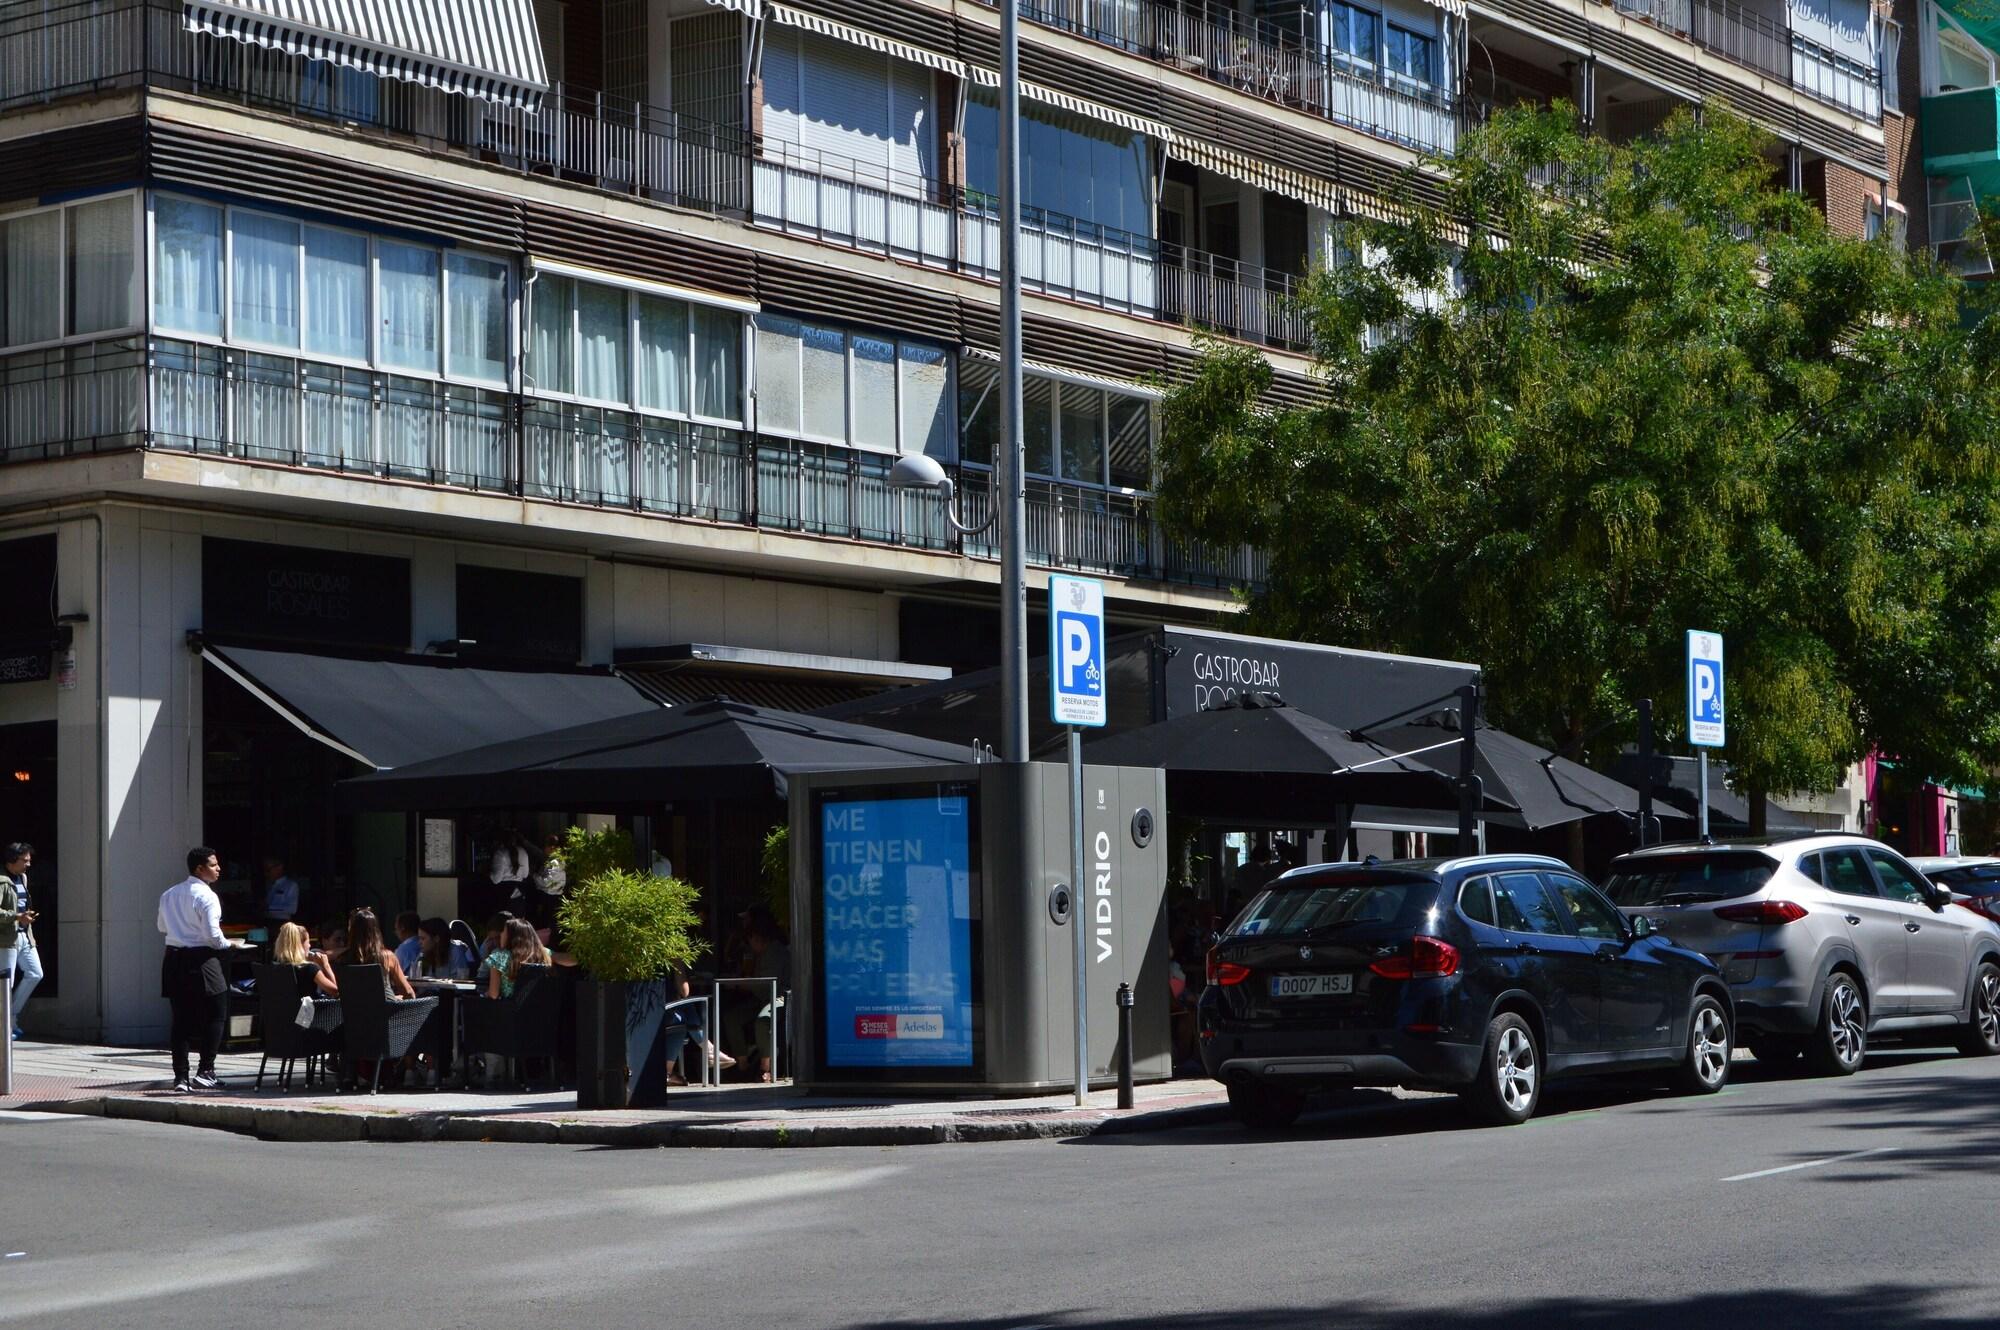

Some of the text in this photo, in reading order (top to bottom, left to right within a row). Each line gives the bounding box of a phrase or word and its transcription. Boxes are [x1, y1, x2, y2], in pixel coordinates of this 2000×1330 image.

[268, 570, 351, 592] GASTROBAR
[268, 590, 351, 619] ROSALES
[1062, 618, 1091, 688] P
[1194, 653, 1280, 687] GASTROBAR
[1695, 663, 1715, 717] P
[826, 808, 865, 832] ME
[825, 840, 922, 864] TIENEN
[826, 874, 883, 902] QUE
[1095, 831, 1113, 963] VIDRIO
[827, 904, 921, 930] HACER
[1282, 975, 1349, 993] 0007 HSJ
[861, 1022, 869, 1035] 3
[903, 1020, 938, 1034] Adeslas
